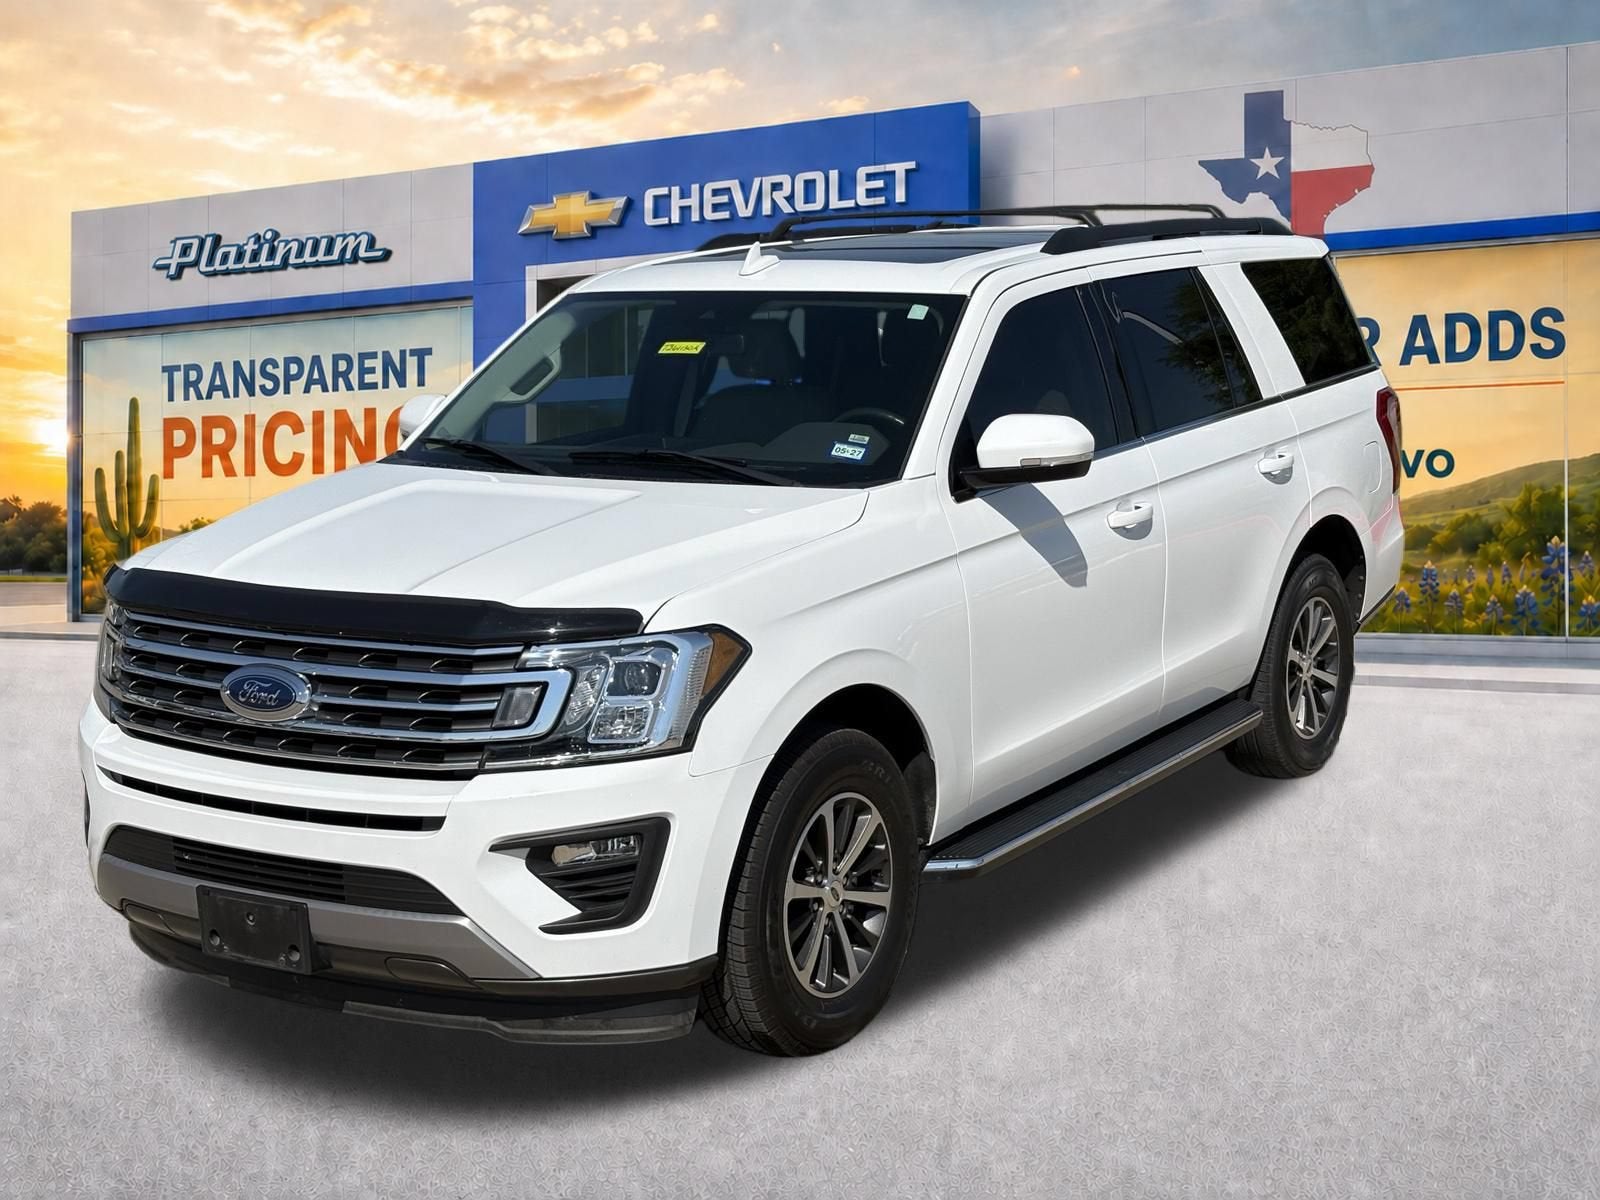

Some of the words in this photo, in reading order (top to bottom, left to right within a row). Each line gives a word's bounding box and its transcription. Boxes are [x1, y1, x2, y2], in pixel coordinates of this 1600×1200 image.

[643, 160, 917, 227] CHEVROLET
[152, 228, 392, 280] Platinum
[1398, 306, 1567, 367] ADDS
[161, 346, 433, 402] TRANSPARENT
[238, 679, 282, 706] Ford
